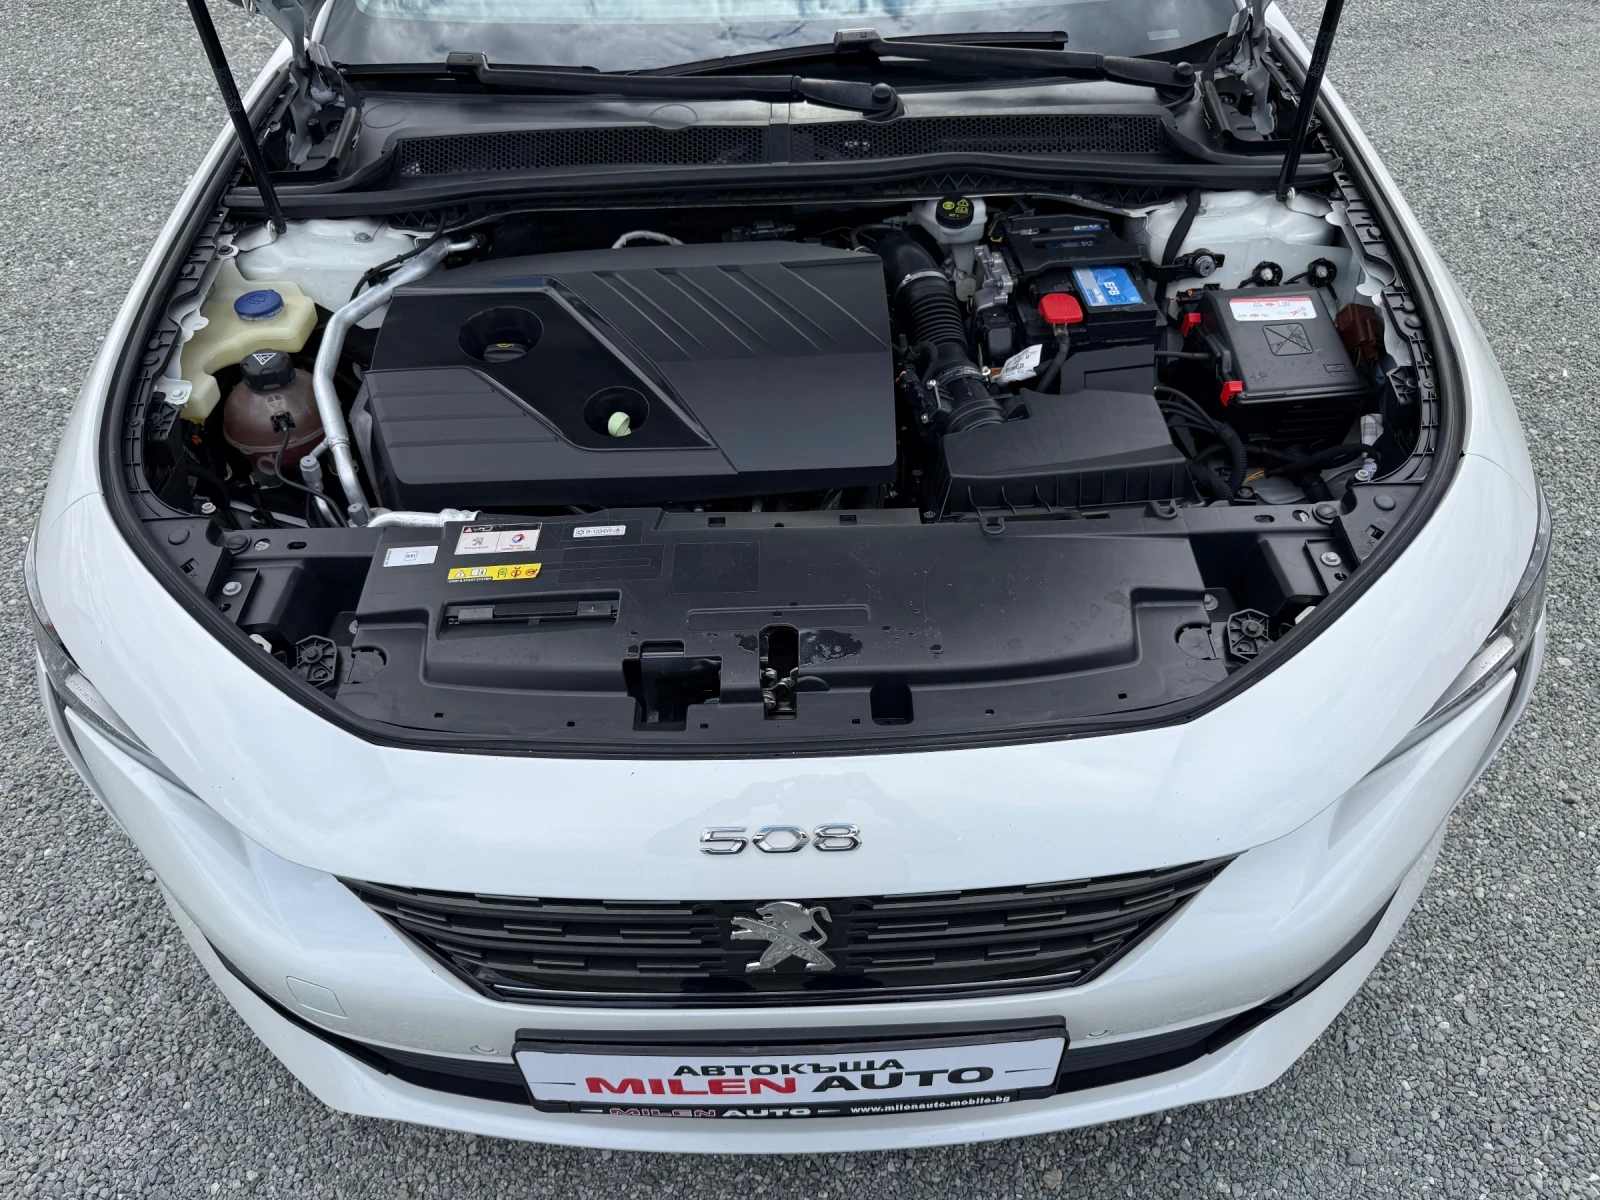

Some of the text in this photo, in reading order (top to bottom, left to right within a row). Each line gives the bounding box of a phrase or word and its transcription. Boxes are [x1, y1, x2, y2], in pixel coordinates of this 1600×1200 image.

[1103, 281, 1120, 296] EFB
[700, 823, 862, 855] 508
[673, 1059, 905, 1077] АВТОКЪЩА
[585, 1066, 994, 1095] MILEN AUTO
[610, 1108, 812, 1118] MILEN AUTO
[850, 1095, 1011, 1114] www.milenauto.mobile.bg
